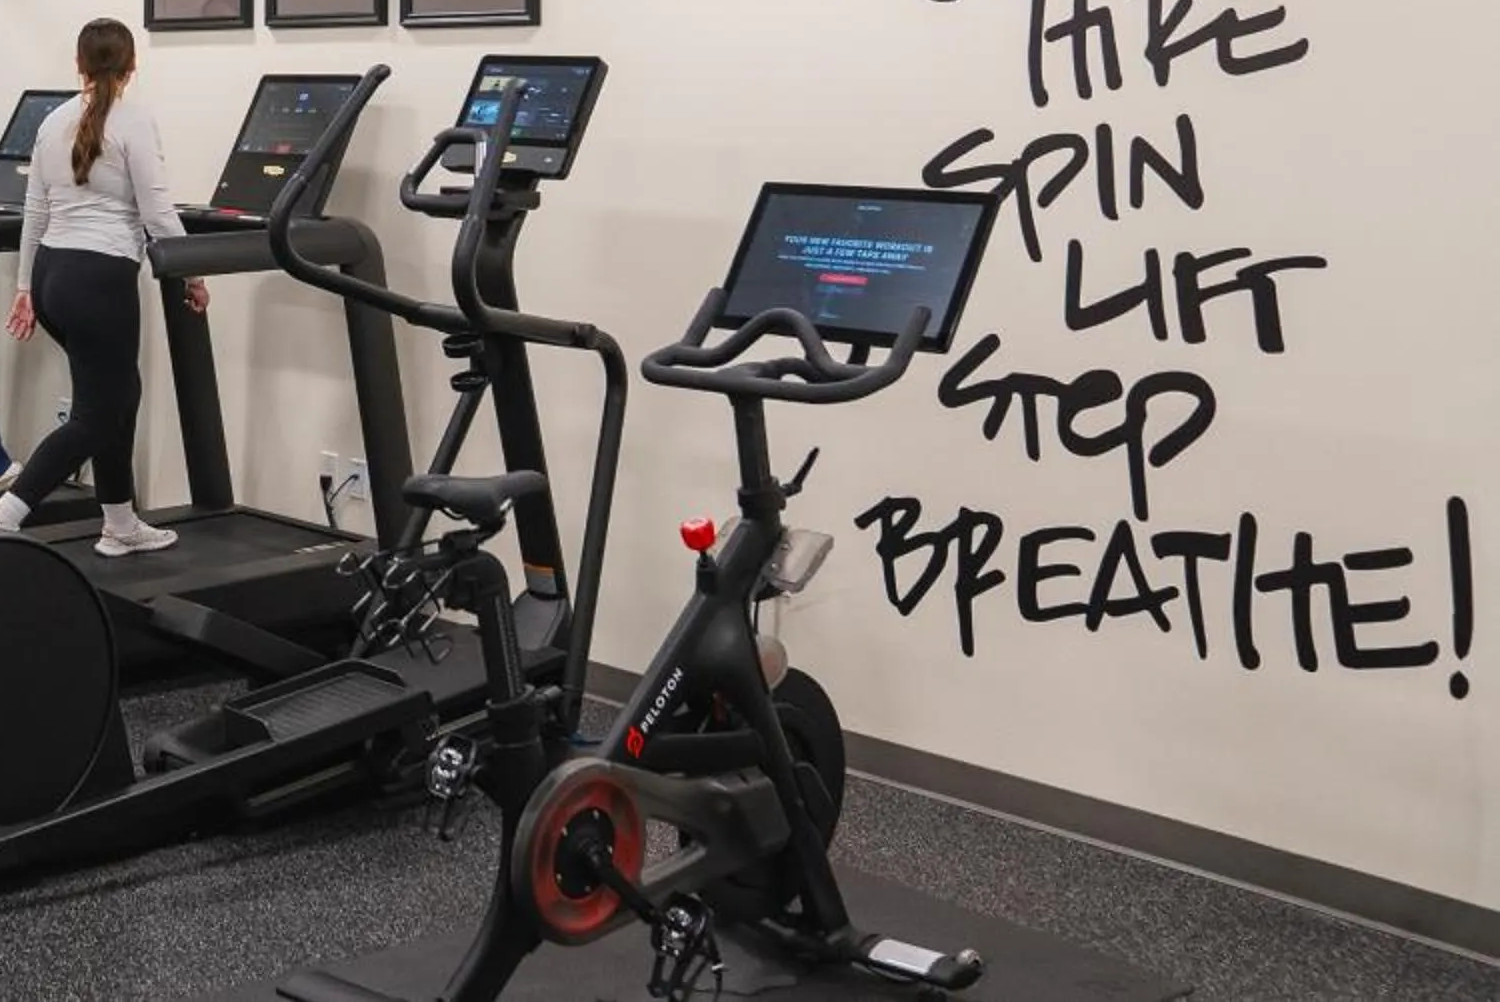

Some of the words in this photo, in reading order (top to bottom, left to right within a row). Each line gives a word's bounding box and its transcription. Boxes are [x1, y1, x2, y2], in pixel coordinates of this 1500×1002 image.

[922, 114, 1204, 262] SPIN
[1065, 239, 1327, 353] LIFT
[854, 496, 1472, 700] BREATHE!
[639, 666, 684, 734] PELOTON
